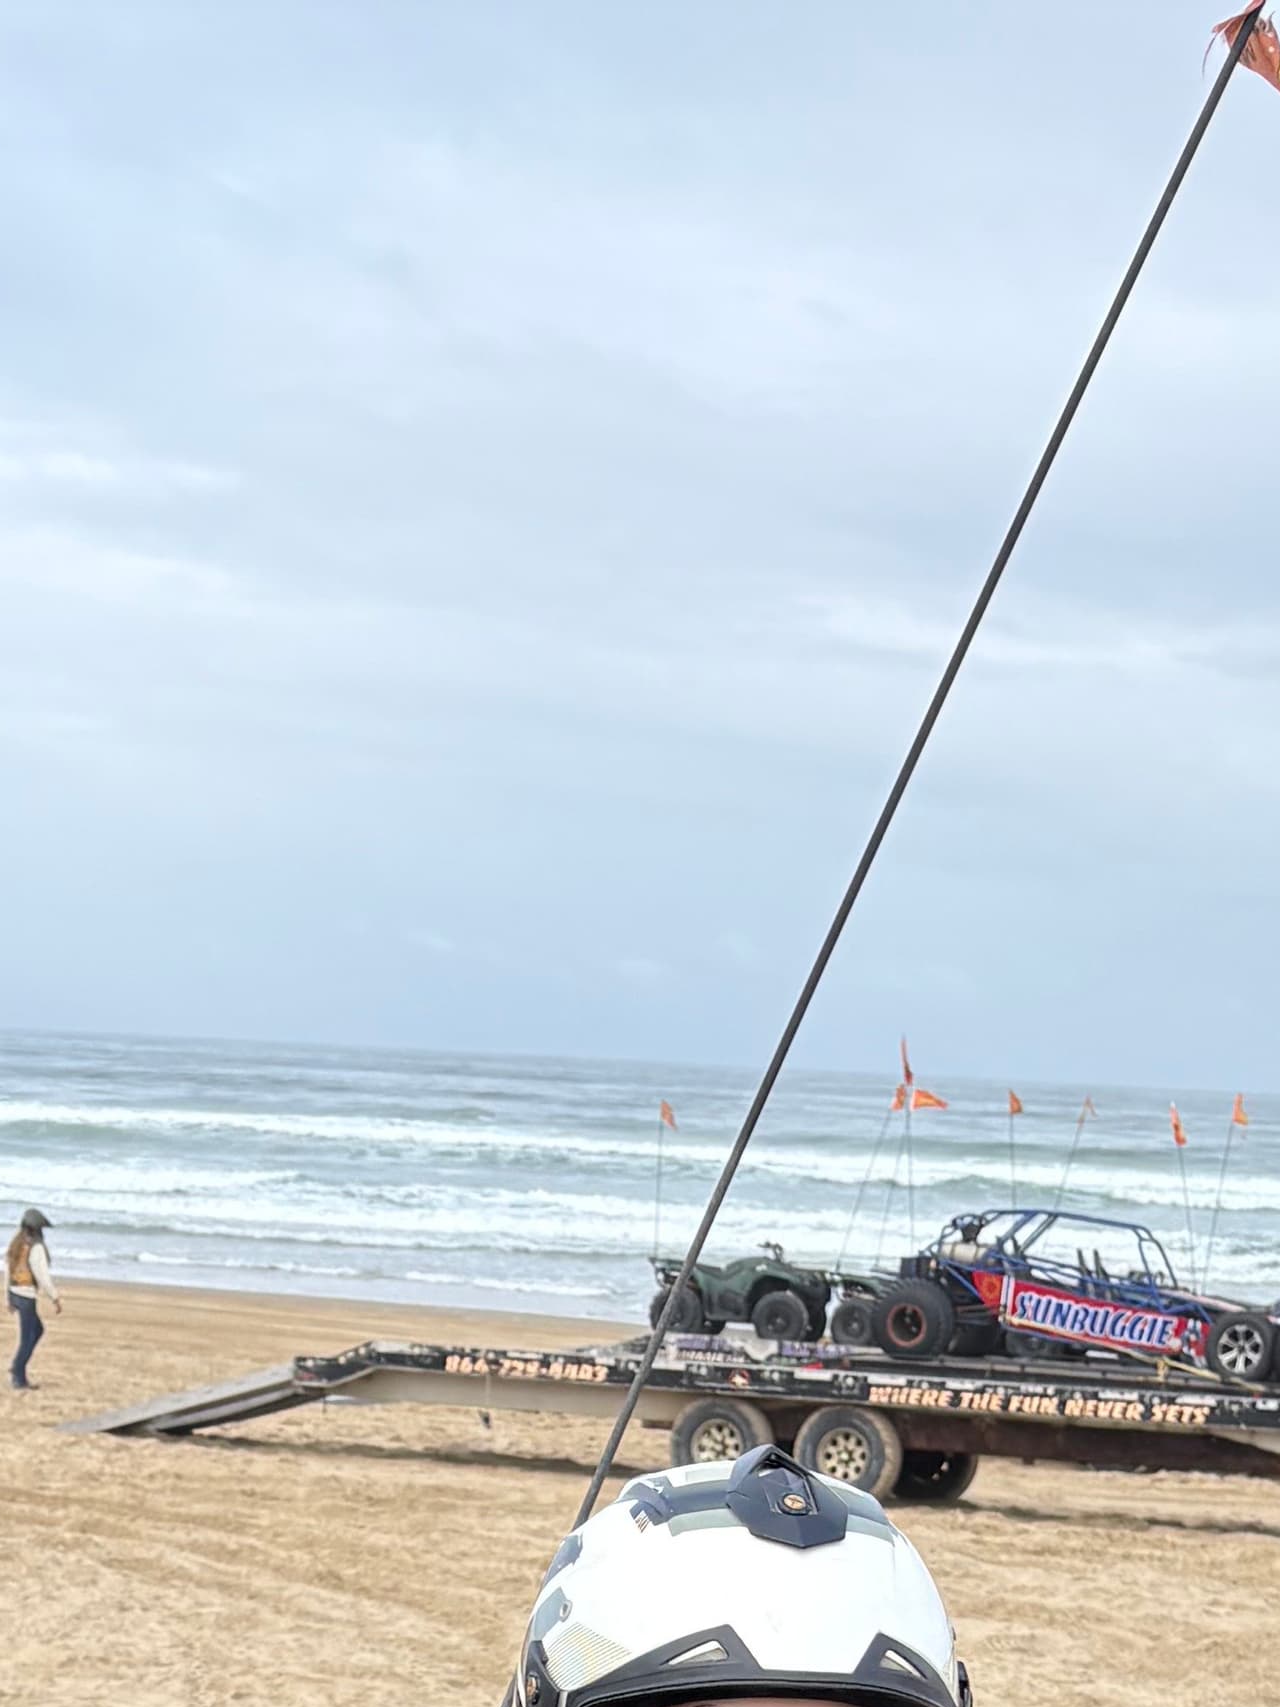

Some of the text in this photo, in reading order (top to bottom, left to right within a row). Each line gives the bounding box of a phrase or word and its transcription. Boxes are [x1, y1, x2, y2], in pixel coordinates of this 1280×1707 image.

[1014, 1290, 1177, 1348] SUNBUGGIE
[869, 1386, 1209, 1425] WHERE THE FUN NEVER SETS
